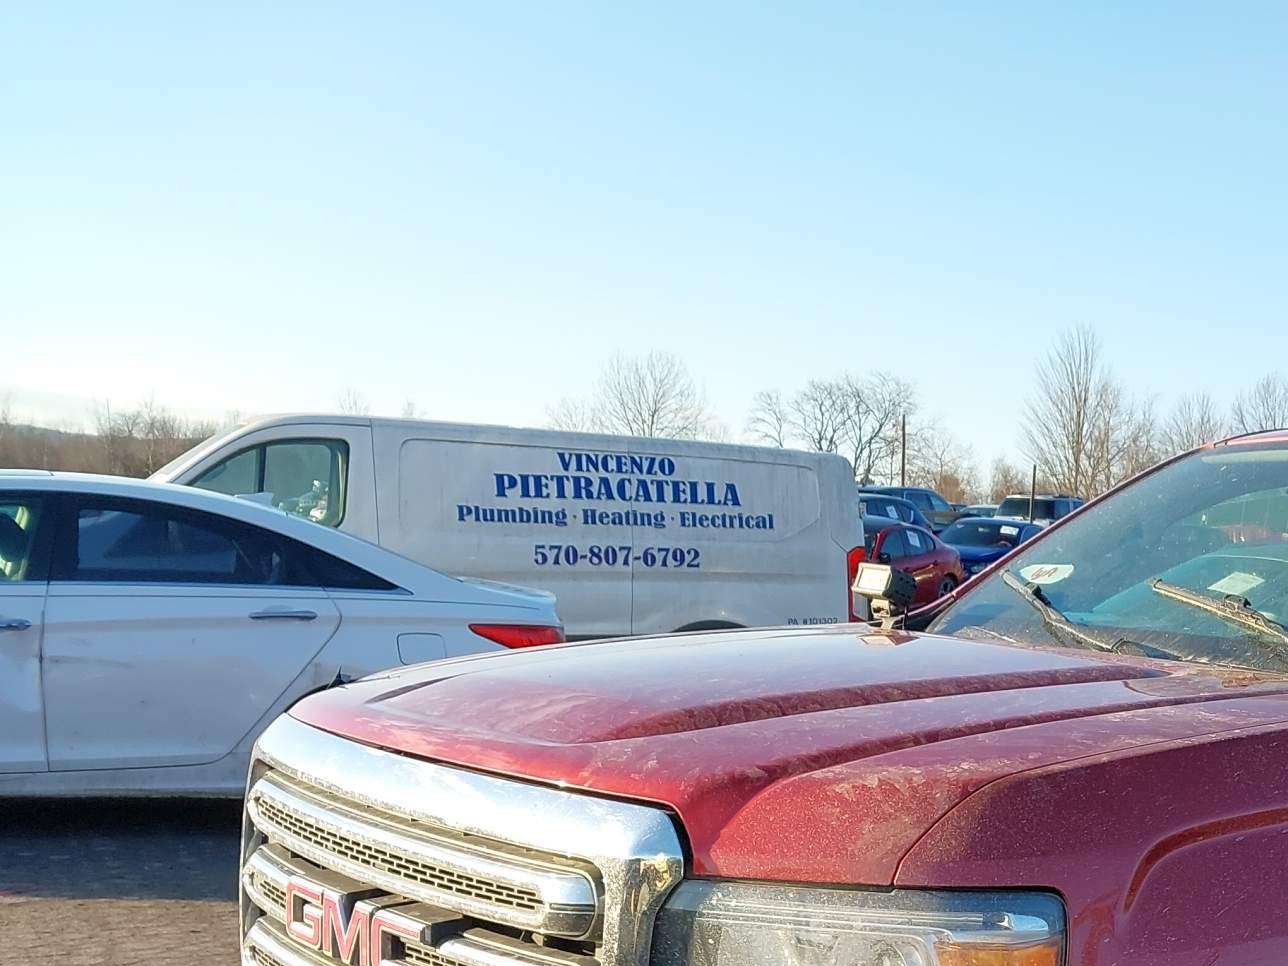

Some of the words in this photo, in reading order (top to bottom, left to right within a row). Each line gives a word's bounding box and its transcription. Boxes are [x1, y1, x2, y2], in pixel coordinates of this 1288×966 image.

[557, 451, 676, 477] VINCENZO
[493, 473, 743, 507] PIETRACATELLA
[457, 504, 568, 528] Plumbing
[581, 508, 667, 530] Heating
[678, 511, 775, 530] Electrical
[533, 544, 701, 568] 570-807-6792
